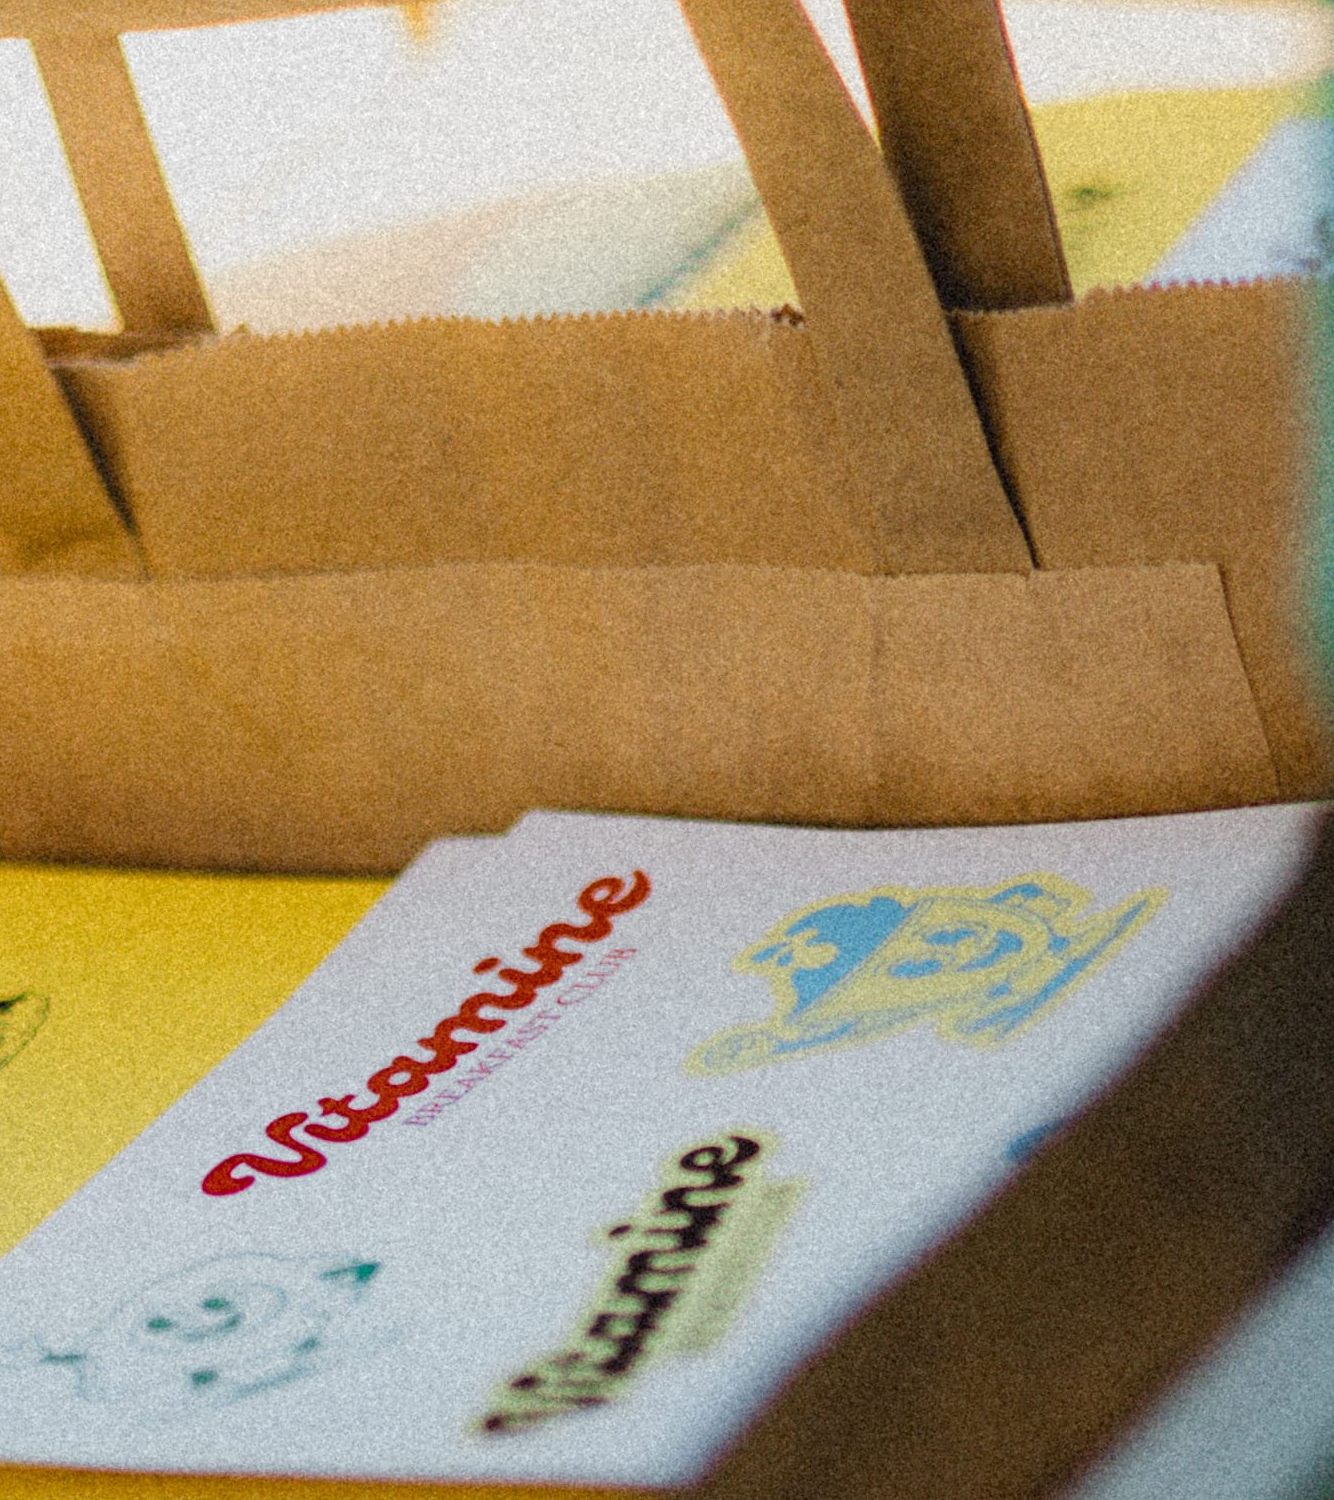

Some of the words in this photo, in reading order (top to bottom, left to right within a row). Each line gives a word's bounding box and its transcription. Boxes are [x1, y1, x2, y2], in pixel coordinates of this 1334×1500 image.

[201, 869, 651, 1195] Vitamine
[402, 1011, 563, 1127] BREAKFAST
[556, 947, 637, 1006] CLUB
